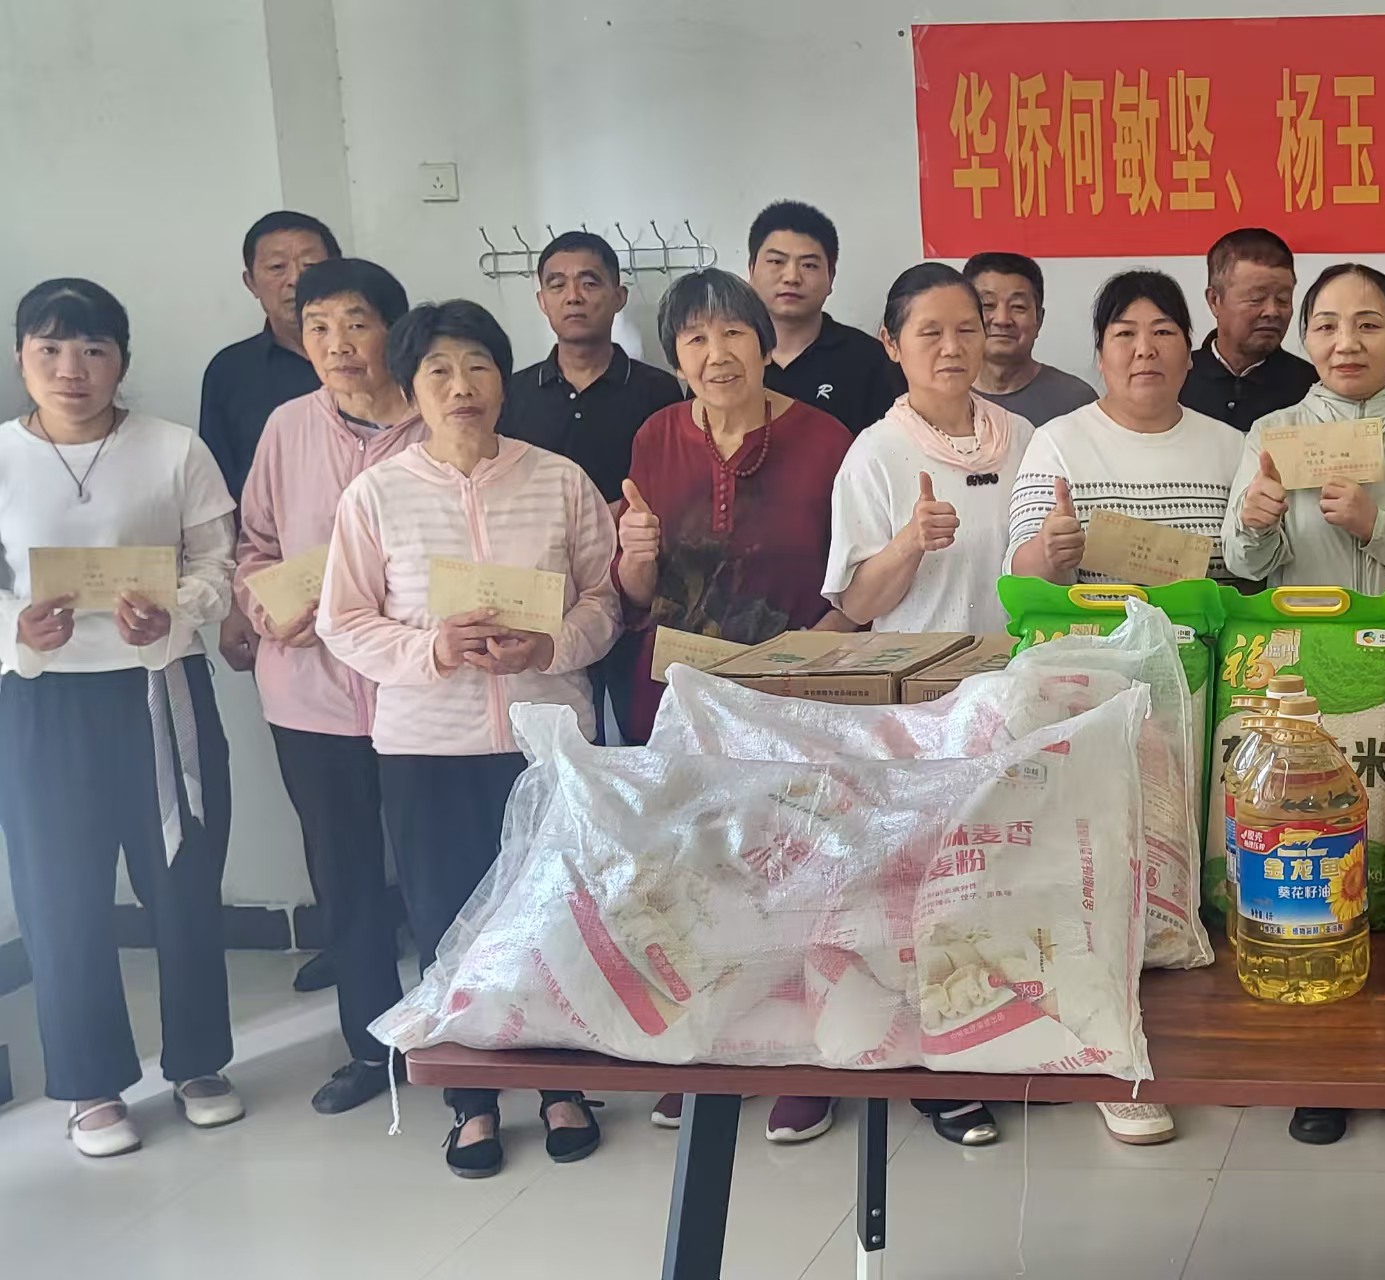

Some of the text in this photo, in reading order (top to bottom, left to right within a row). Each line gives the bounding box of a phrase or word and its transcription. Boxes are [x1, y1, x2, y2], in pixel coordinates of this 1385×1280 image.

[816, 384, 833, 399] R
[1264, 857, 1341, 881] 金龙鱼
[1278, 885, 1332, 899] 葵花籽油
